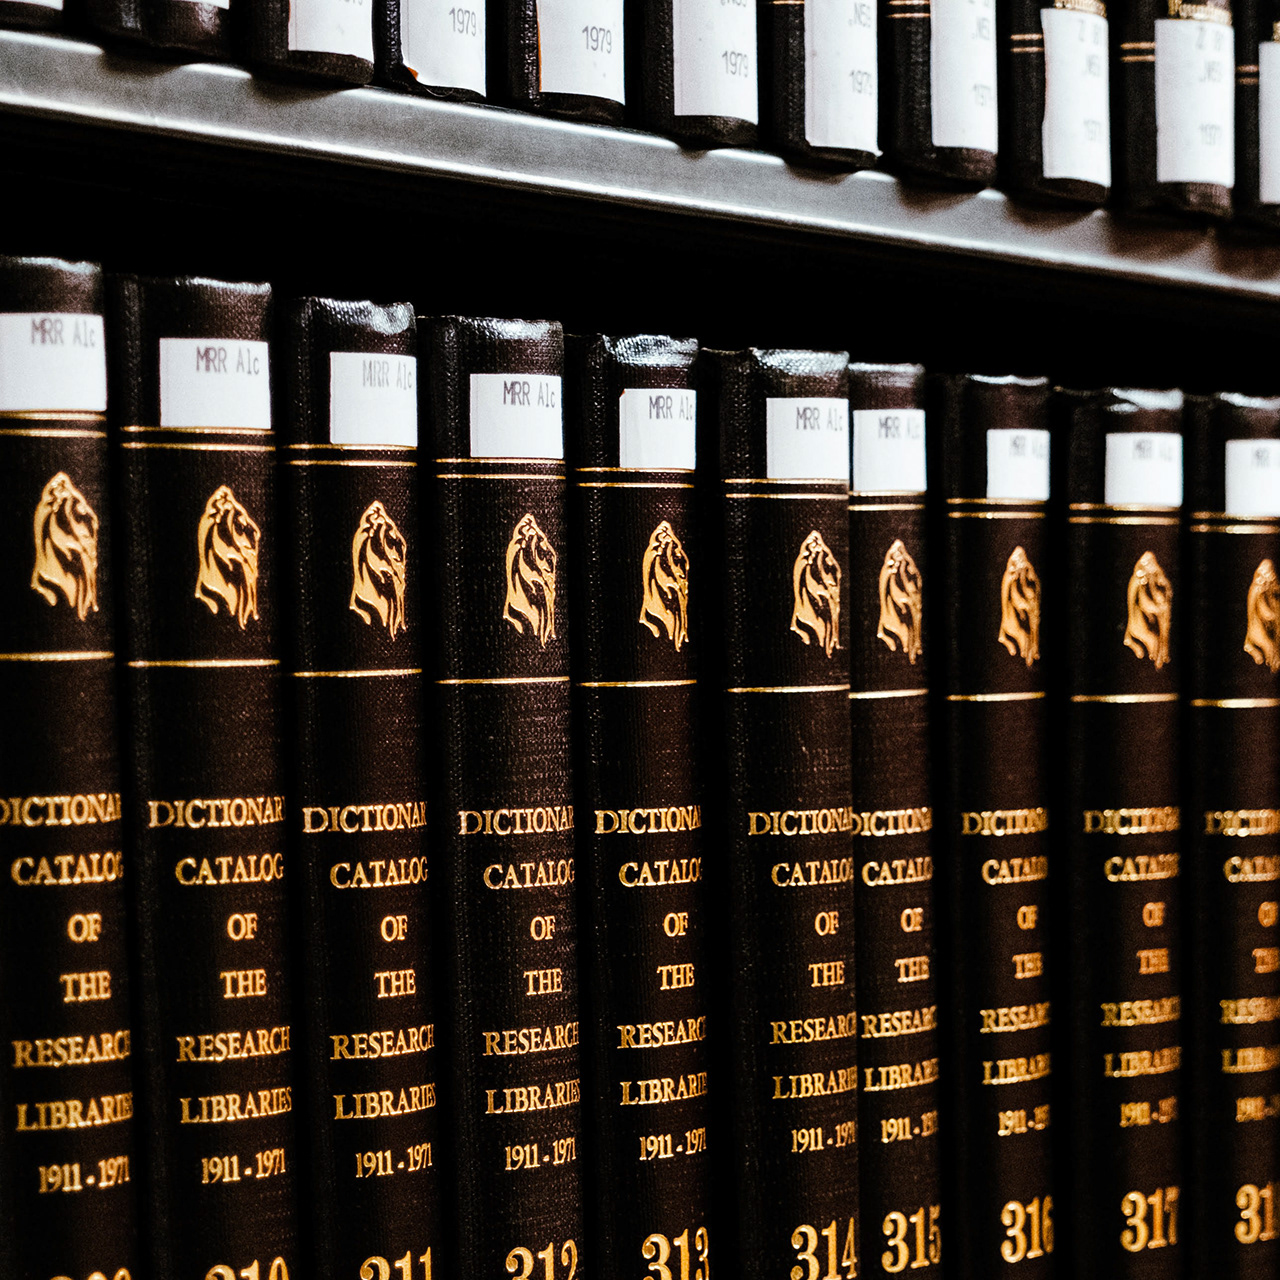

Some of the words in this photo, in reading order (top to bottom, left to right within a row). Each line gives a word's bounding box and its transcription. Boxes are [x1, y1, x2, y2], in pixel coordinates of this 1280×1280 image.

[582, 26, 612, 54] 1979
[503, 381, 530, 406] MRR
[649, 395, 672, 419] MRR
[175, 853, 284, 885] CATALOG
[330, 856, 428, 889] CATALOG
[484, 858, 575, 891] CATALOG
[67, 912, 102, 943] OF
[227, 913, 258, 941] OF
[380, 915, 408, 942] OF
[530, 915, 556, 941] OF
[662, 912, 688, 937] OF
[815, 911, 839, 936] OF
[60, 970, 111, 1003] THE
[220, 968, 267, 999] THE
[374, 969, 416, 999] THE
[523, 968, 563, 996] THE
[657, 963, 695, 990] THE
[808, 961, 845, 987] THE
[177, 1026, 290, 1063] RESEARCH
[330, 1024, 434, 1059] RESEARCH
[482, 1022, 579, 1056] RESEARCH
[180, 1087, 291, 1123] LIBRARIES
[333, 1083, 436, 1120] LIBRARIES
